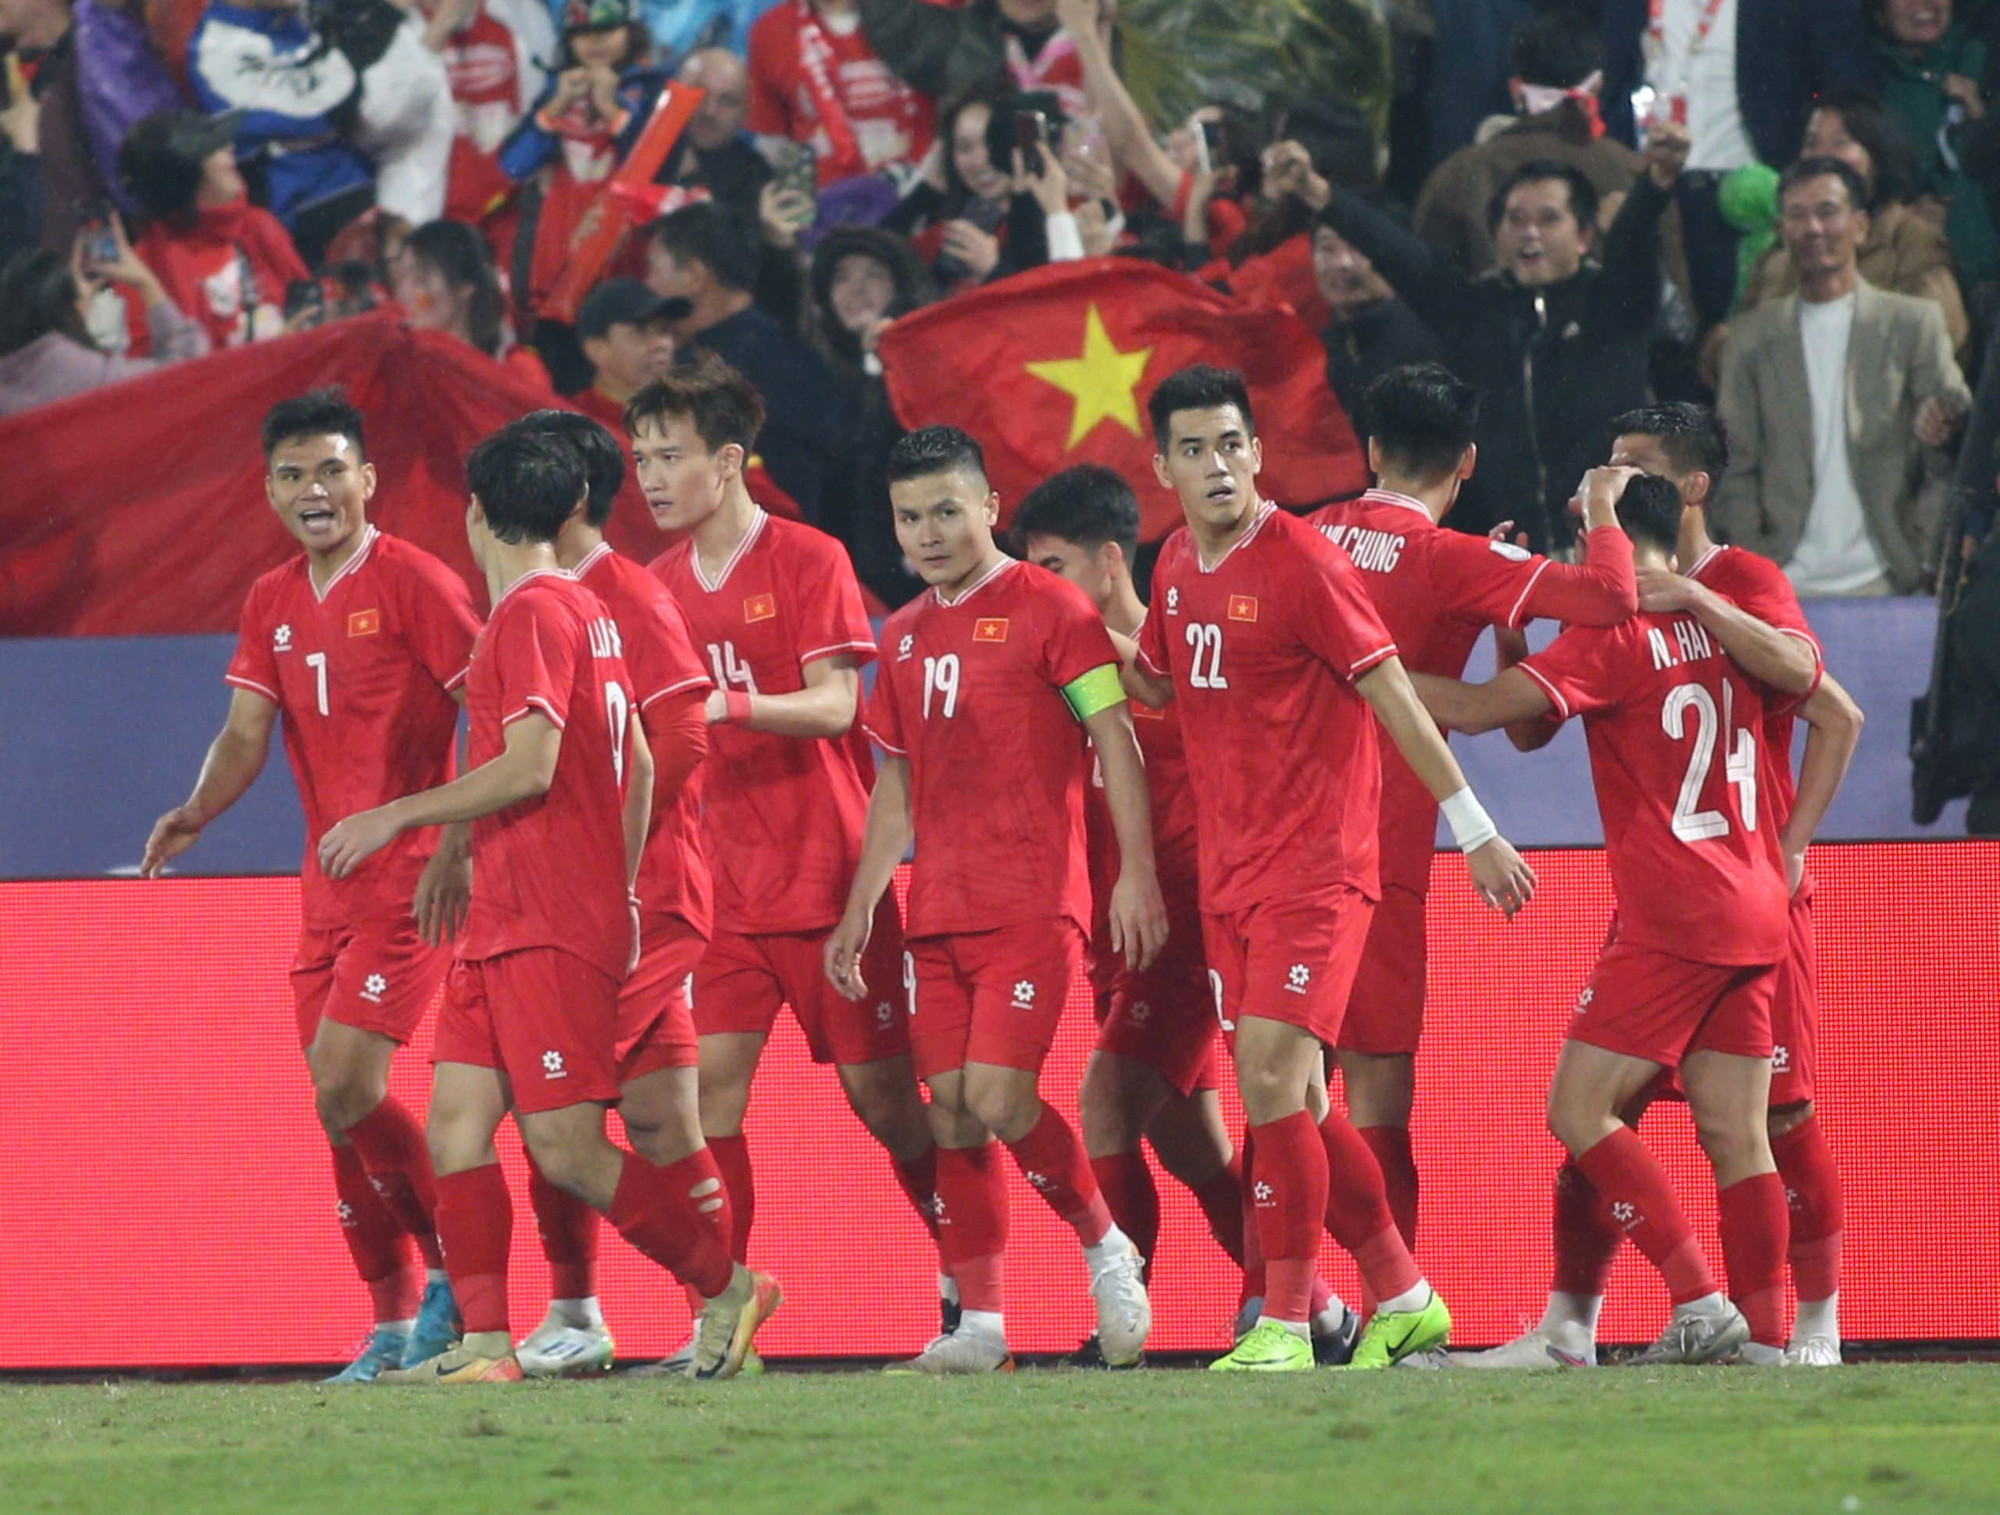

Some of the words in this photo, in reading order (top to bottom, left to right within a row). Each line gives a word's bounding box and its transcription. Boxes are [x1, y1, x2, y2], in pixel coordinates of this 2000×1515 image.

[1342, 526, 1406, 573] CHUNG
[305, 651, 330, 716] 7
[706, 640, 758, 696] 14
[923, 653, 960, 720] 19
[1186, 622, 1229, 689] 22
[1661, 677, 1756, 842] 24
